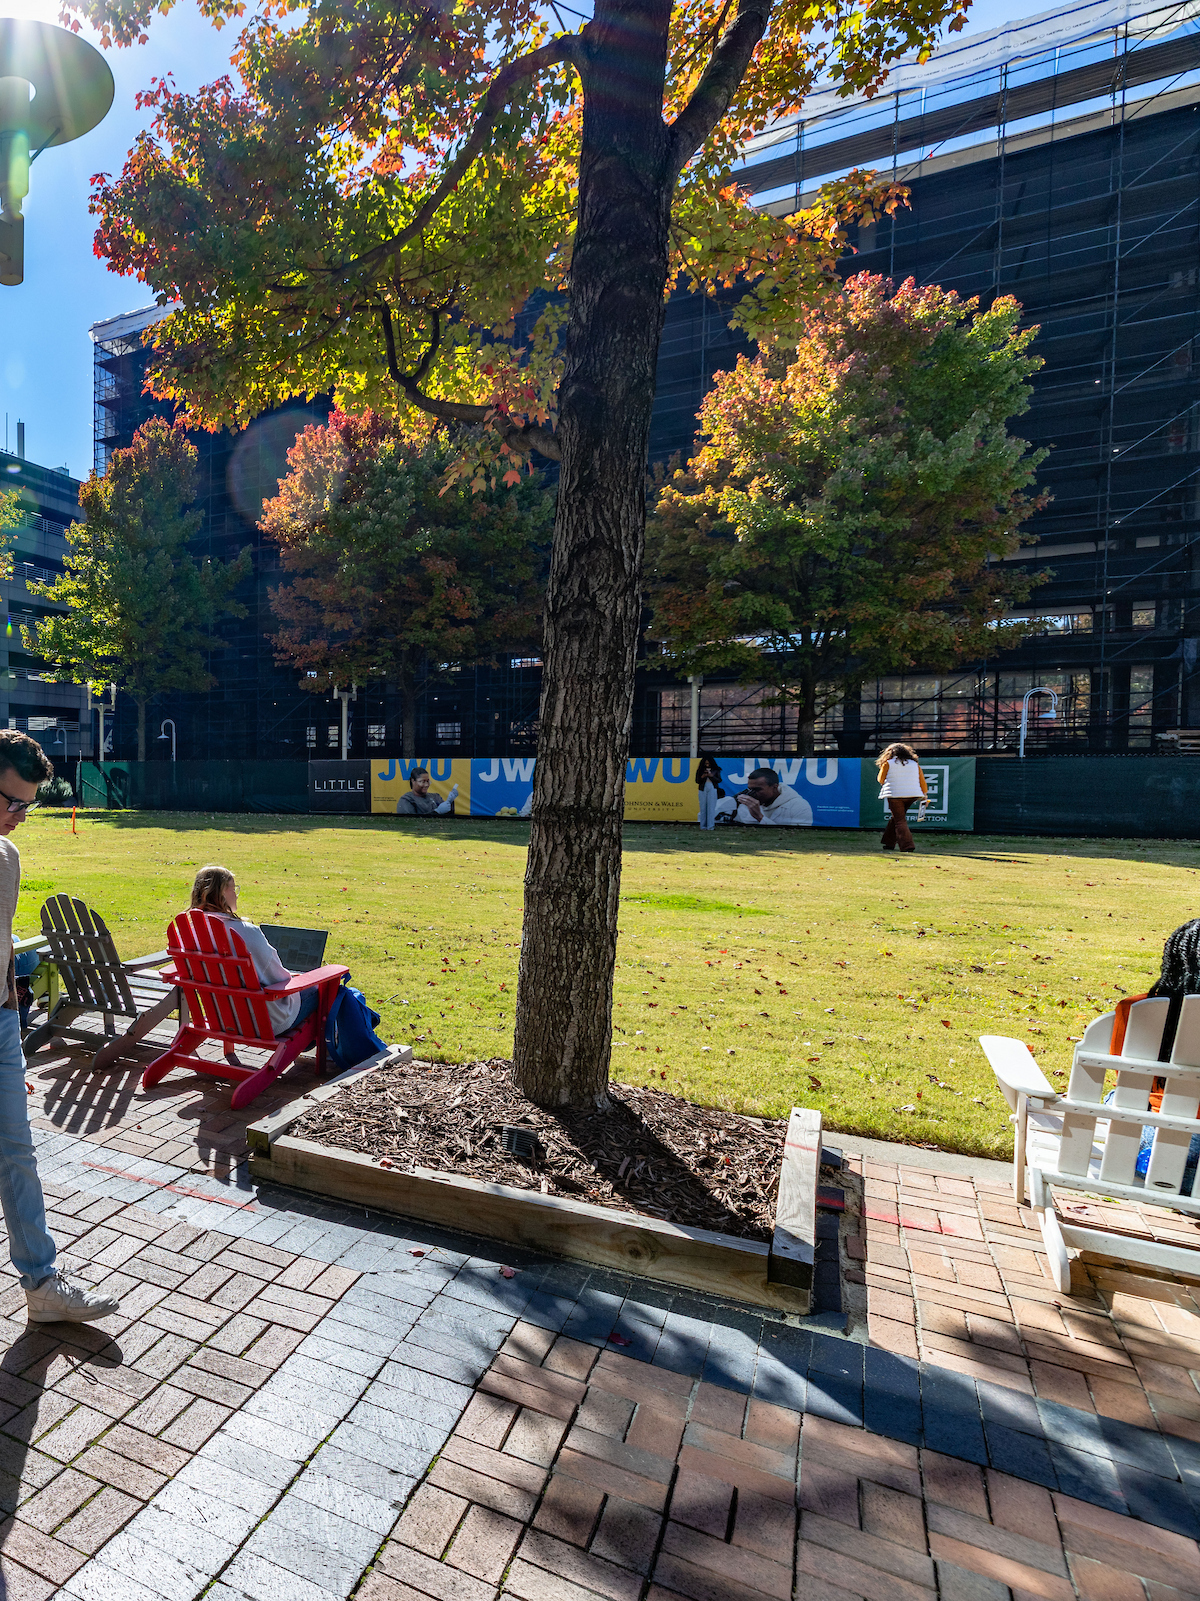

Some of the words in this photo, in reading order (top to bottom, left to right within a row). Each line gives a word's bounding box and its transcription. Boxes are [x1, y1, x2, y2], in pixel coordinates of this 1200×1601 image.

[377, 758, 452, 782] JWU
[478, 758, 536, 782] JW
[625, 758, 690, 783] WU
[728, 758, 839, 786] JWU
[314, 779, 364, 790] LITTLE
